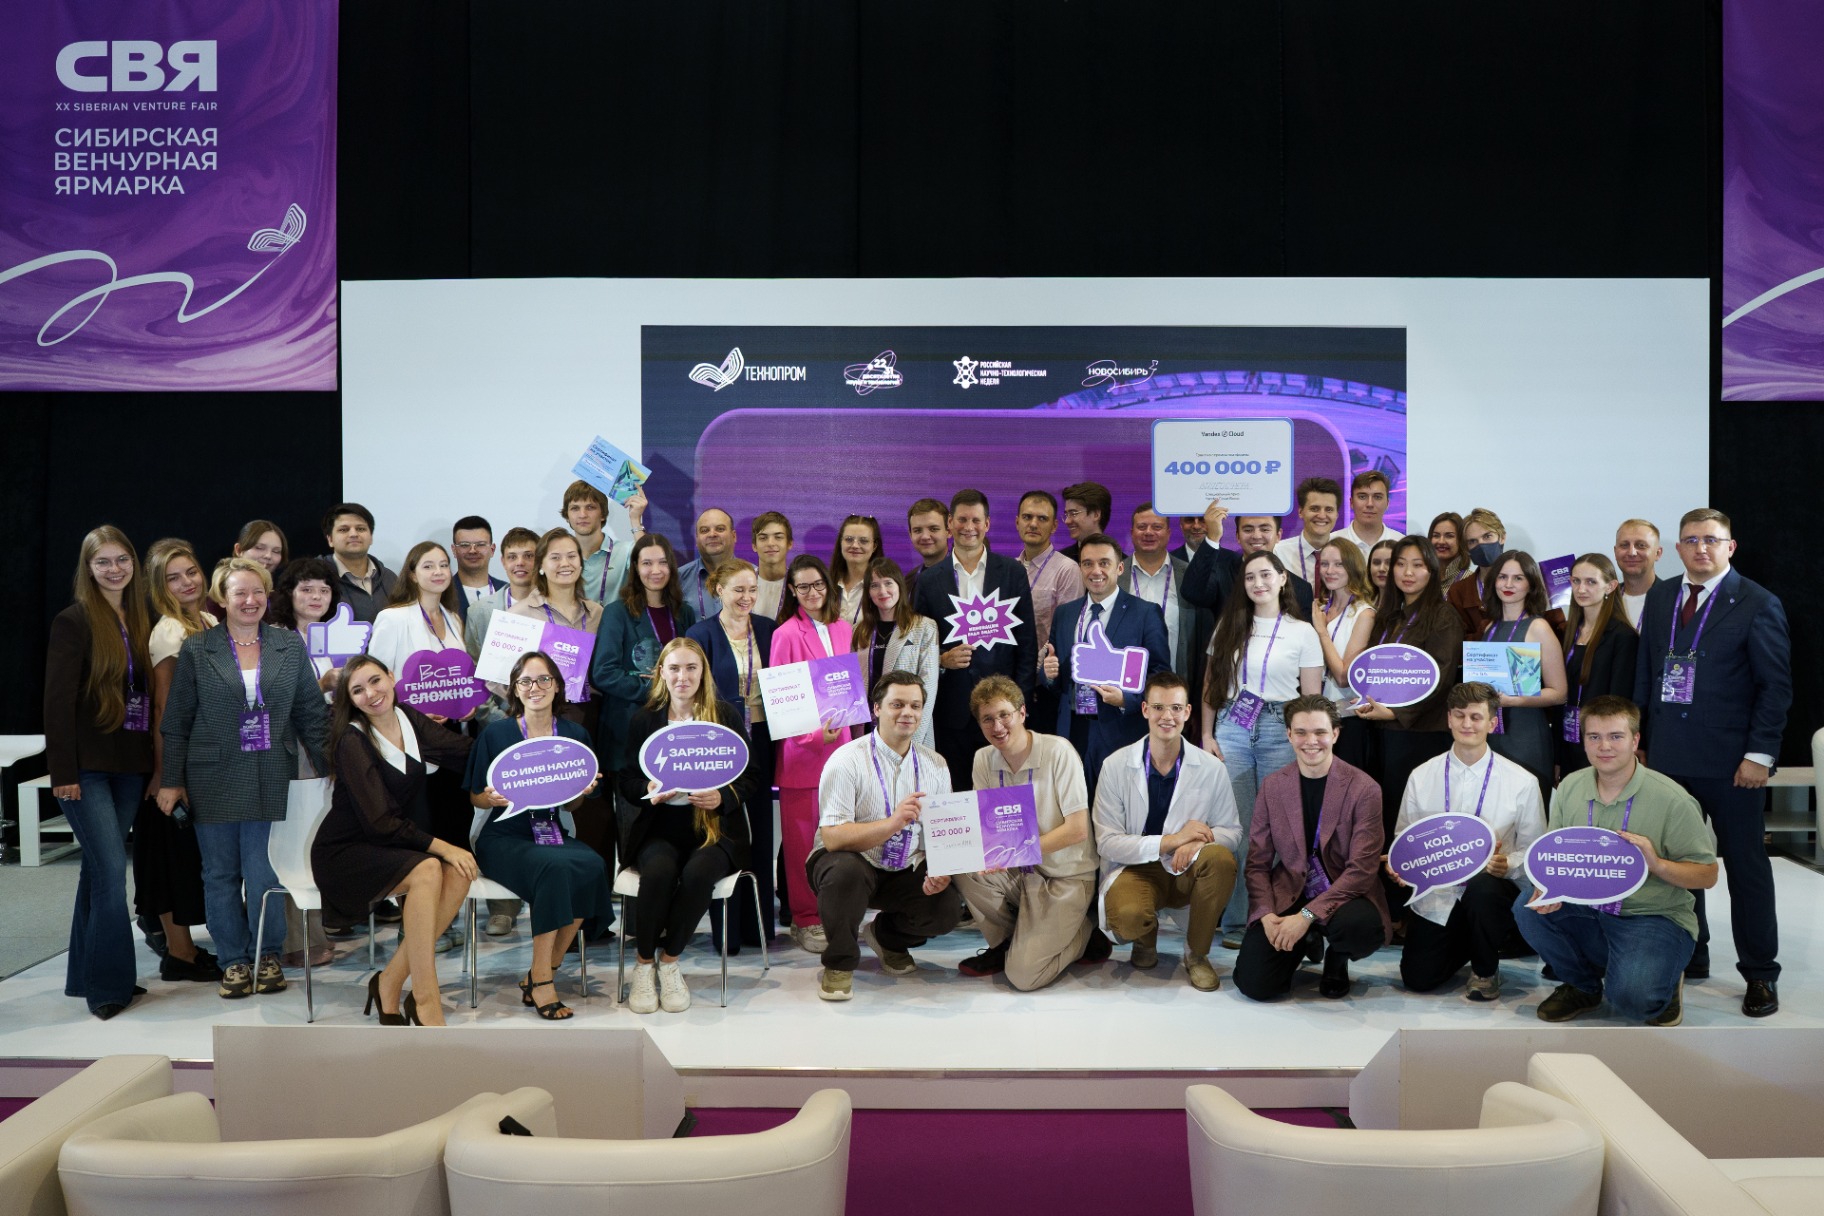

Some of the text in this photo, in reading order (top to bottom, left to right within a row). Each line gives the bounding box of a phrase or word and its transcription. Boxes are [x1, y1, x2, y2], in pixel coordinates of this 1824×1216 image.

[55, 40, 217, 92] СВЯ
[55, 102, 217, 111] XX SIBERIAN VENTURE FAIR
[55, 127, 218, 147] СИБИРСКАЯ
[54, 151, 217, 171] ВЕНЧУРНАЯ
[54, 176, 185, 195] ЯРМАРКА
[980, 360, 1012, 368] РОССИЙСКАЯ
[744, 366, 806, 381] ТЕХНОПРОМ
[1088, 367, 1149, 376] НОВОСИБИРЬ
[1164, 461, 1211, 475] 400
[1214, 460, 1262, 475] 000
[1551, 566, 1569, 576] СВЯ
[502, 643, 516, 651] 000
[553, 641, 580, 654] СВЯ
[419, 664, 461, 681] ВСЕ
[825, 670, 849, 681] СВЯ
[404, 676, 474, 691] ГЕНИАЛЬНОЕ
[1366, 676, 1431, 685] ЕДИНОРОГИ
[409, 687, 474, 704] СЛОЖНО
[771, 697, 784, 705] 200
[669, 746, 736, 757] ЗАРЯЖЕН
[501, 758, 586, 778] ВО ИМЯ НАУКИ
[673, 760, 733, 771] НА ИДЕИ
[503, 768, 588, 790] И ИННОВАЦИЙ!
[994, 804, 1022, 815] СВЯ
[1424, 834, 1453, 850] КОД
[1401, 838, 1485, 871] СИБИРСКОГО
[1537, 852, 1635, 865] ИНВЕСТИРУЮ
[1421, 857, 1474, 879] УСПЕХА
[1545, 866, 1626, 879] В БУДУЩЕЕ
